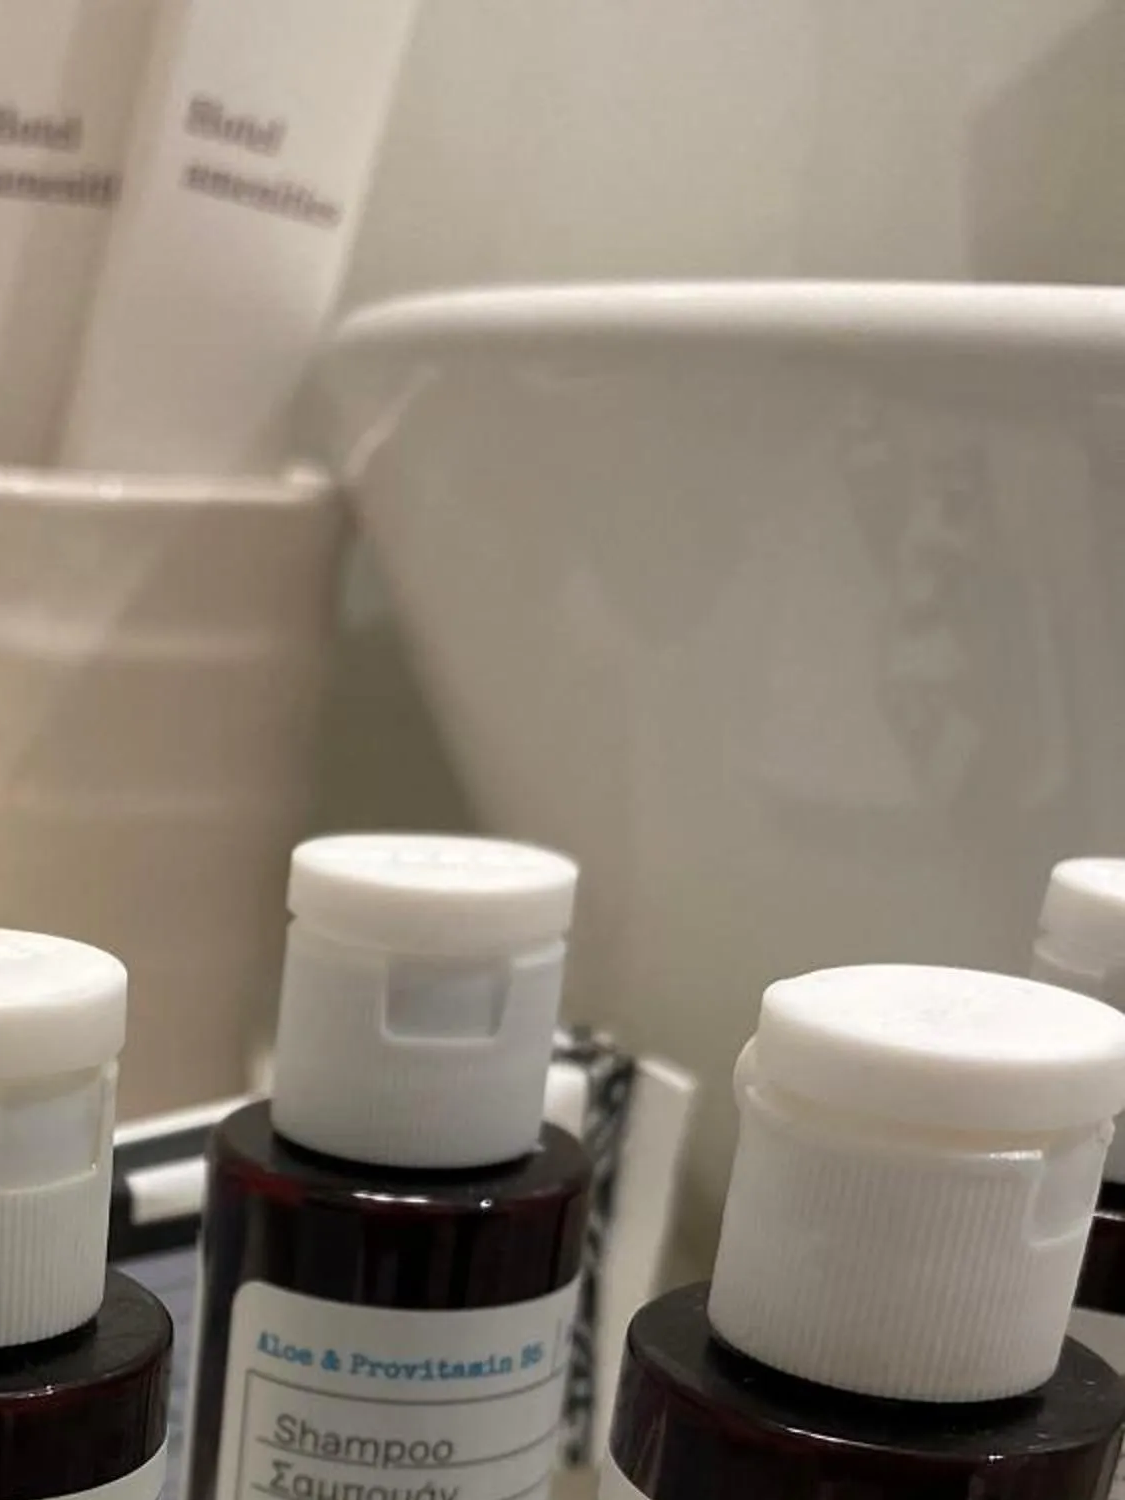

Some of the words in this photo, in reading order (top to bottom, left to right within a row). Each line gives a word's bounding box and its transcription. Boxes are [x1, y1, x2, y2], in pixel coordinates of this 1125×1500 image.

[257, 1330, 314, 1367] Aloe
[321, 1349, 342, 1373] &
[349, 1352, 514, 1382] Provitamin
[275, 1412, 454, 1469] Shampoo
